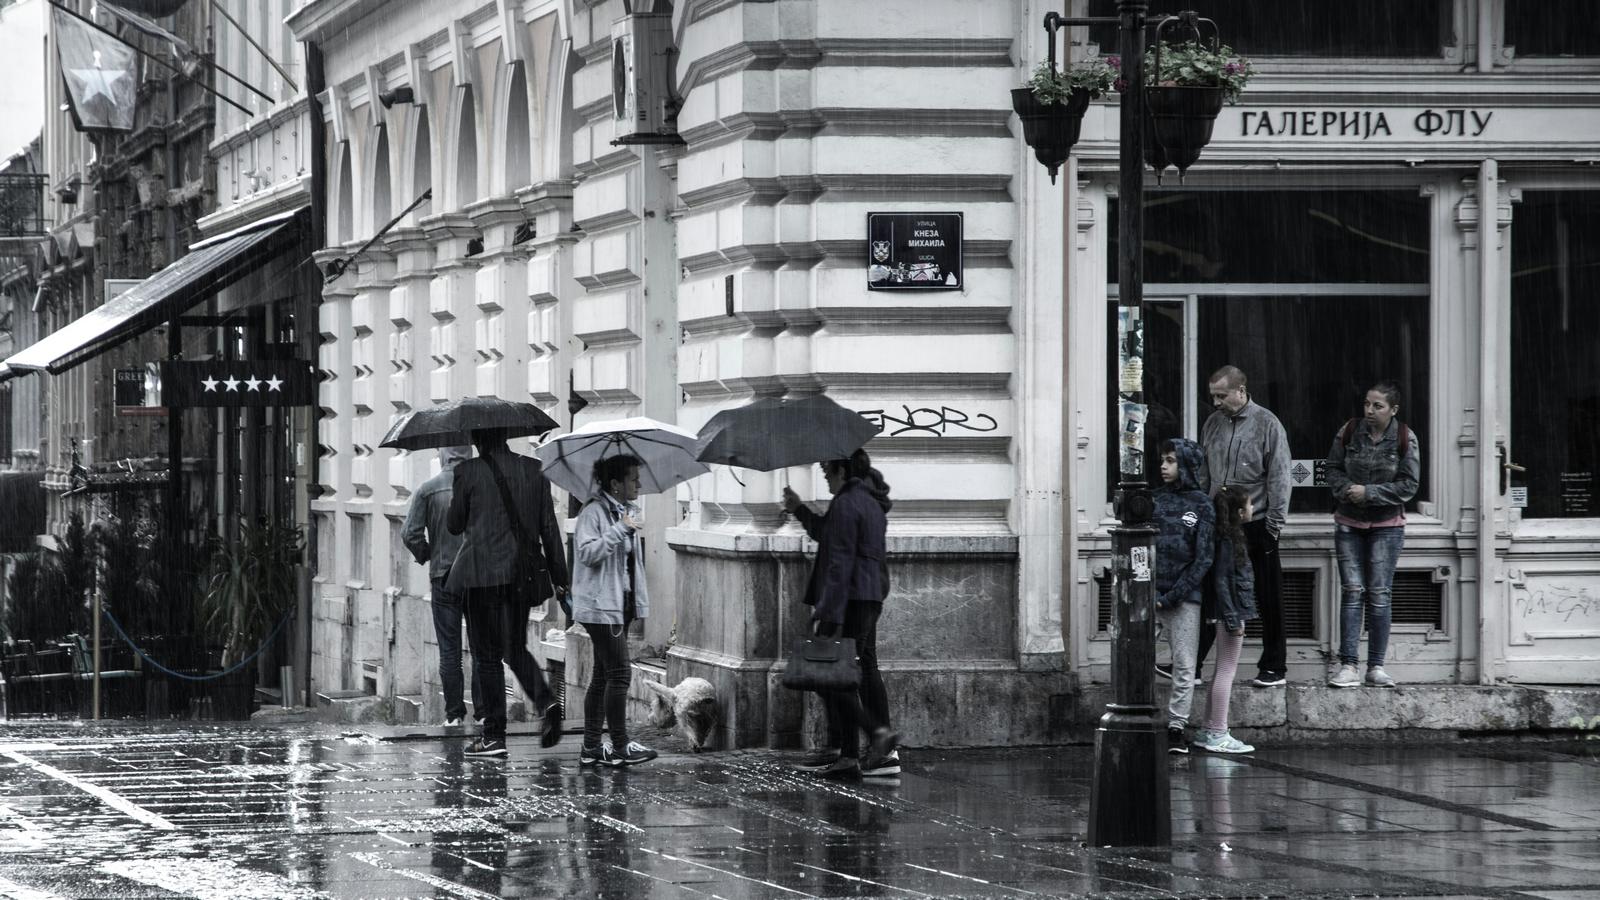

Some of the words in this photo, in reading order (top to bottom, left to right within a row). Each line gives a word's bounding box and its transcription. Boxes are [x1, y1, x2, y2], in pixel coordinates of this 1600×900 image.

[1241, 111, 1392, 139] ГАЛЕРИЈА
[1413, 109, 1493, 136] ФЛУ
[914, 229, 939, 237] КНЕЗА
[908, 239, 945, 247] МИХАИЛА
